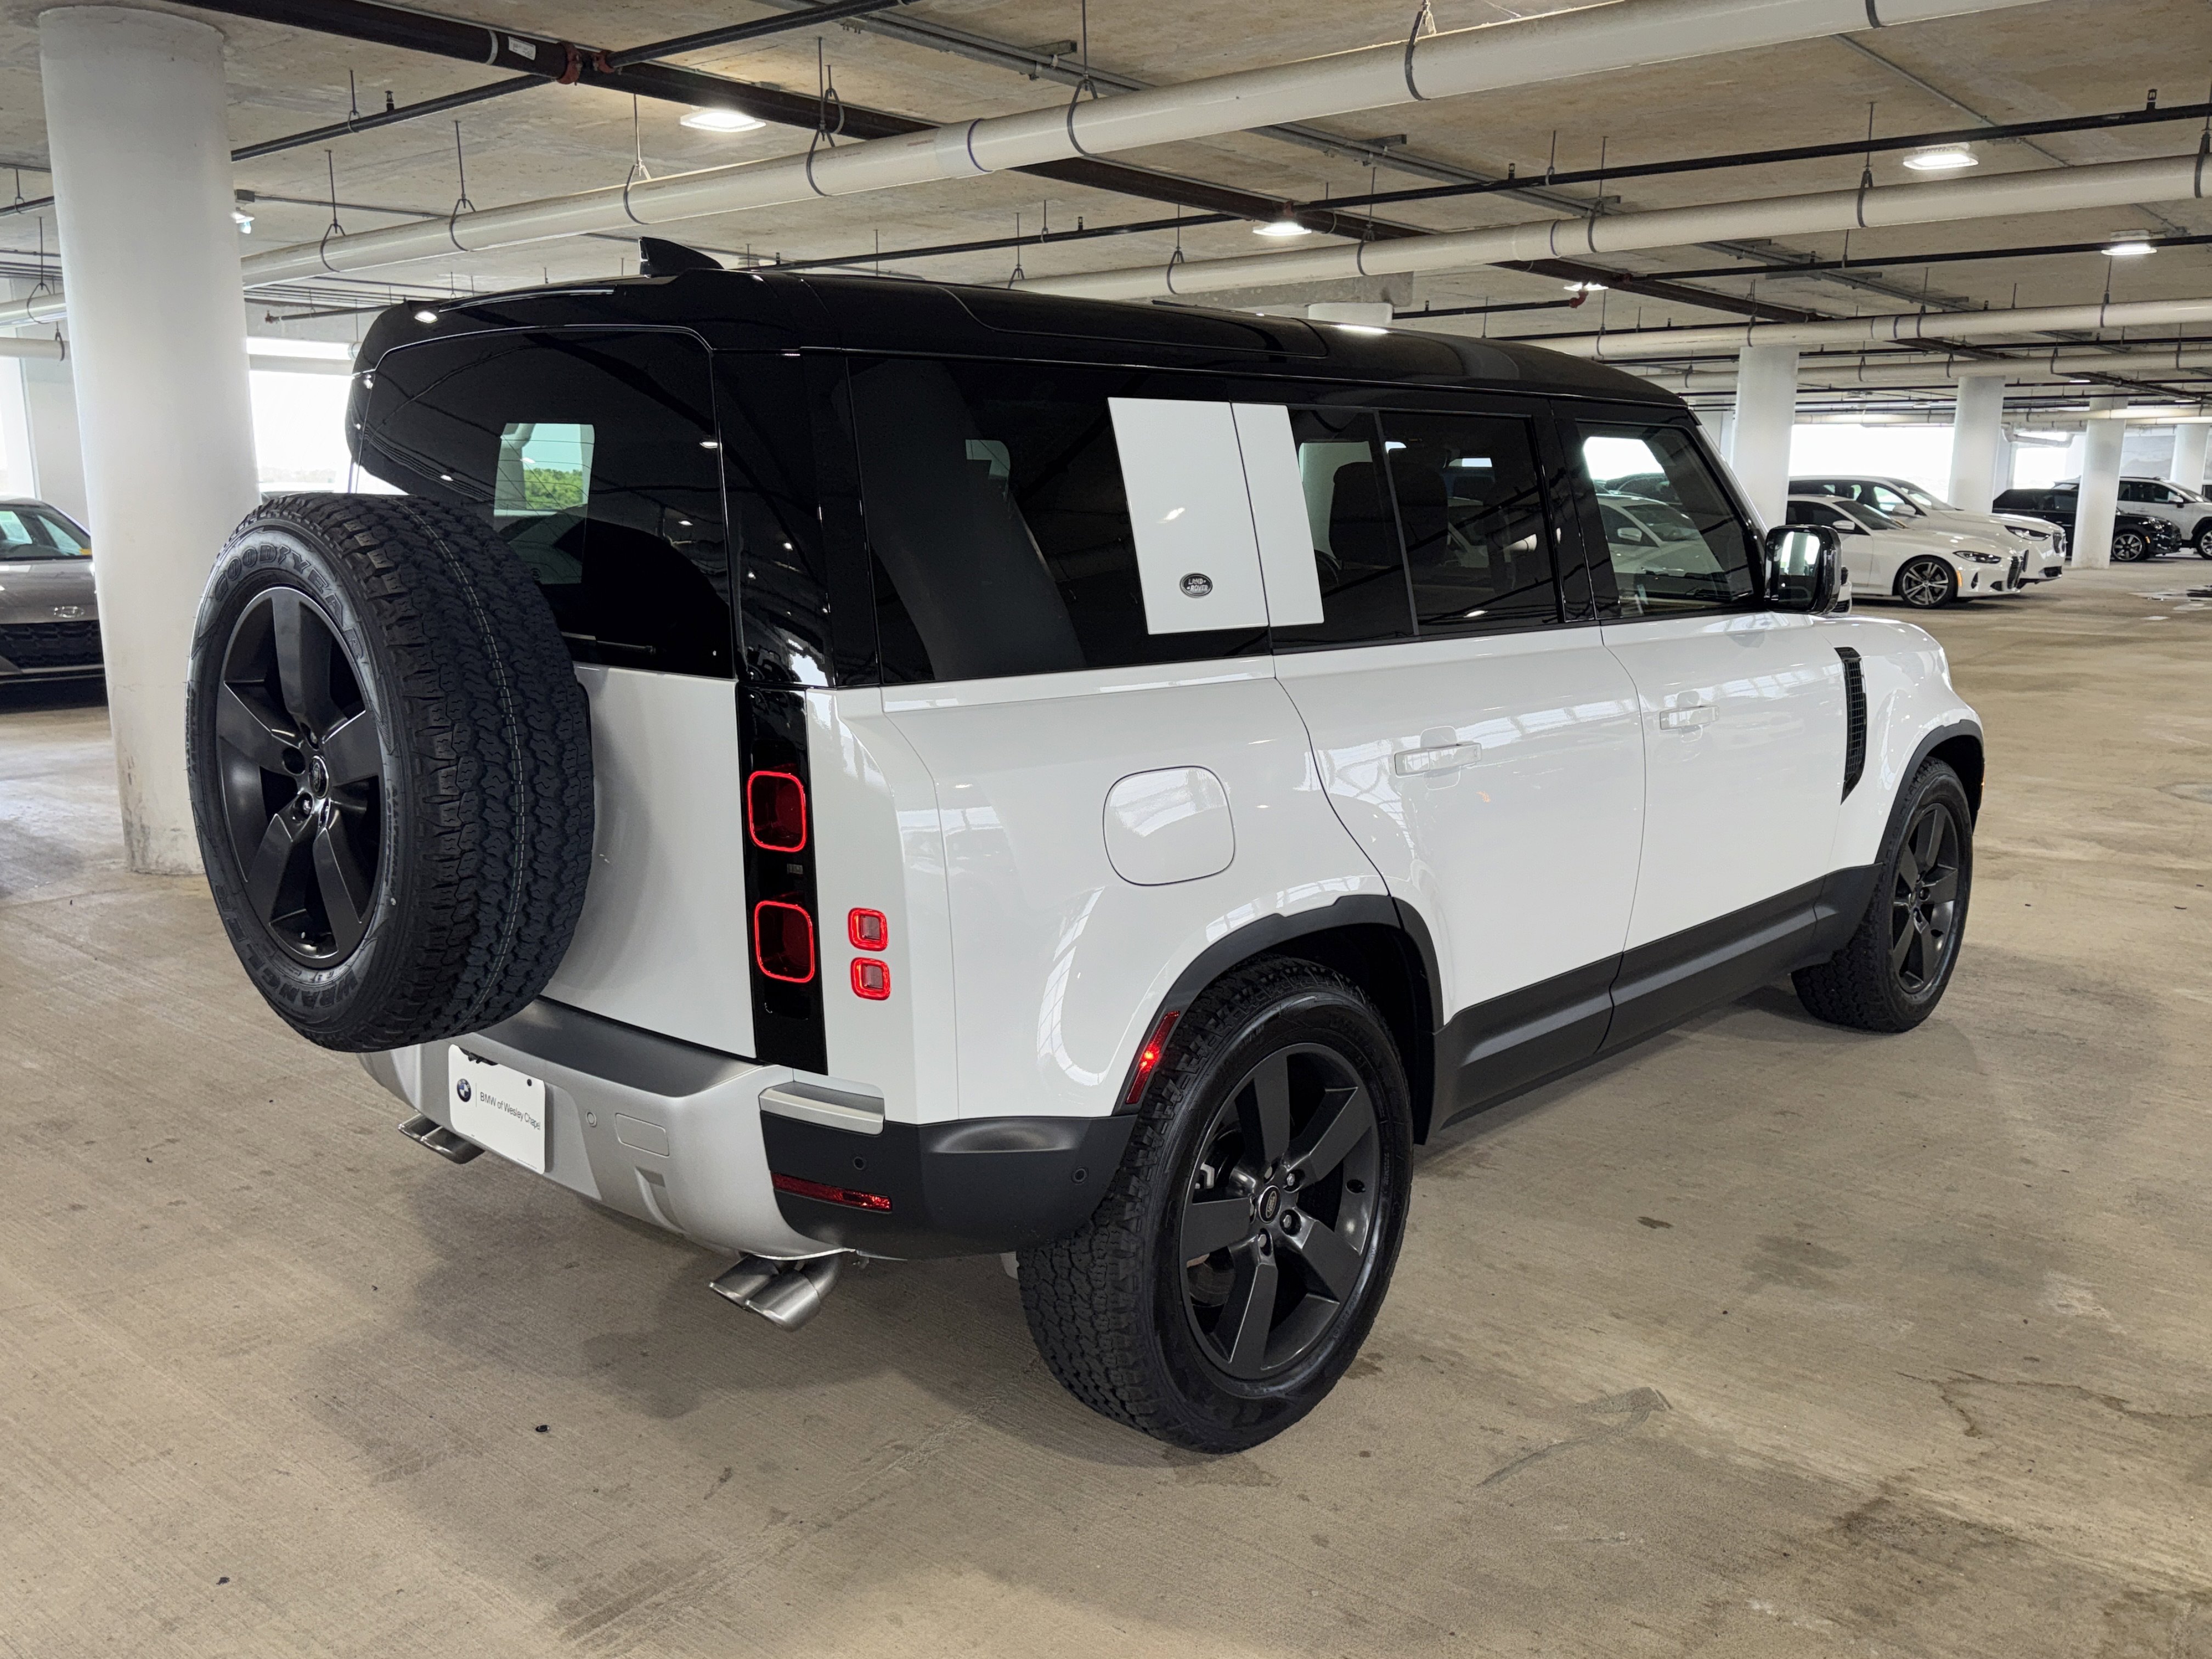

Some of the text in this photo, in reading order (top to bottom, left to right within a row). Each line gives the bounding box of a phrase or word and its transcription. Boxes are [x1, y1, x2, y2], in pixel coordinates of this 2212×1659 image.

[214, 544, 364, 659] GOODYEAR
[480, 1092, 541, 1131] BMW of Wesley Chapel
